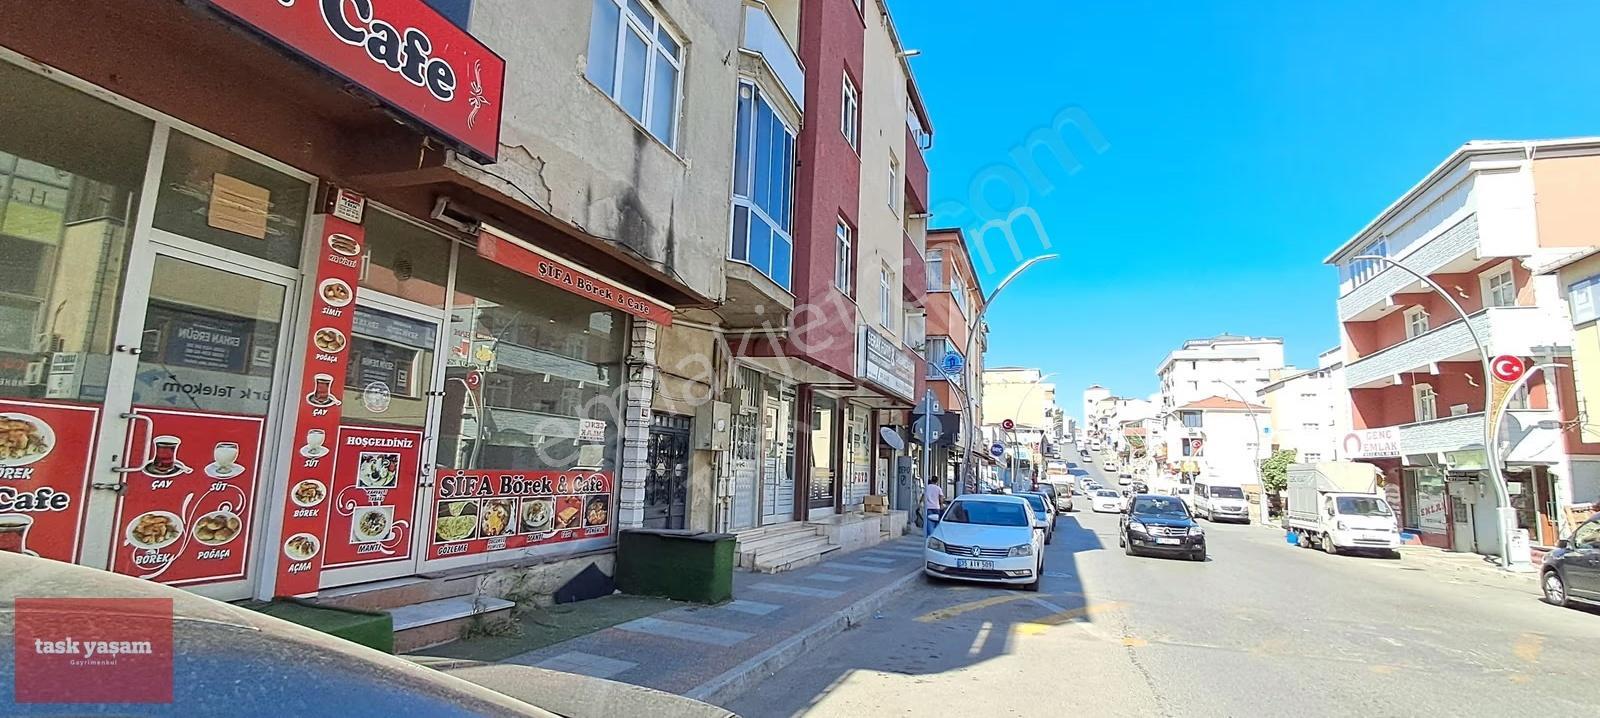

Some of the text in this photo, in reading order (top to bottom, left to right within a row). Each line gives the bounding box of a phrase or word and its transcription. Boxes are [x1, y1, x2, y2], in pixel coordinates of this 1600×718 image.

[318, 0, 457, 102] Cafe
[537, 260, 650, 315] ŞİFA Börek & Cafe
[321, 305, 343, 317] SİMİT
[315, 352, 338, 364] POĞAÇA
[312, 408, 328, 417] ÇAY
[346, 436, 414, 449] HOŞGELDİNİZ
[1363, 441, 1398, 452] EMLAK
[304, 457, 319, 468] SÜT
[151, 479, 174, 491] ÇAY
[209, 481, 229, 492] SÜT
[439, 470, 603, 498] ŞİFA Börek & Cafe
[0, 487, 71, 513] Cafe
[293, 507, 320, 518] BÖREK
[197, 548, 231, 560] POĞAÇA
[438, 543, 468, 556] GÖZLEME
[135, 550, 171, 566] BÖREK
[288, 561, 312, 574] AÇMA
